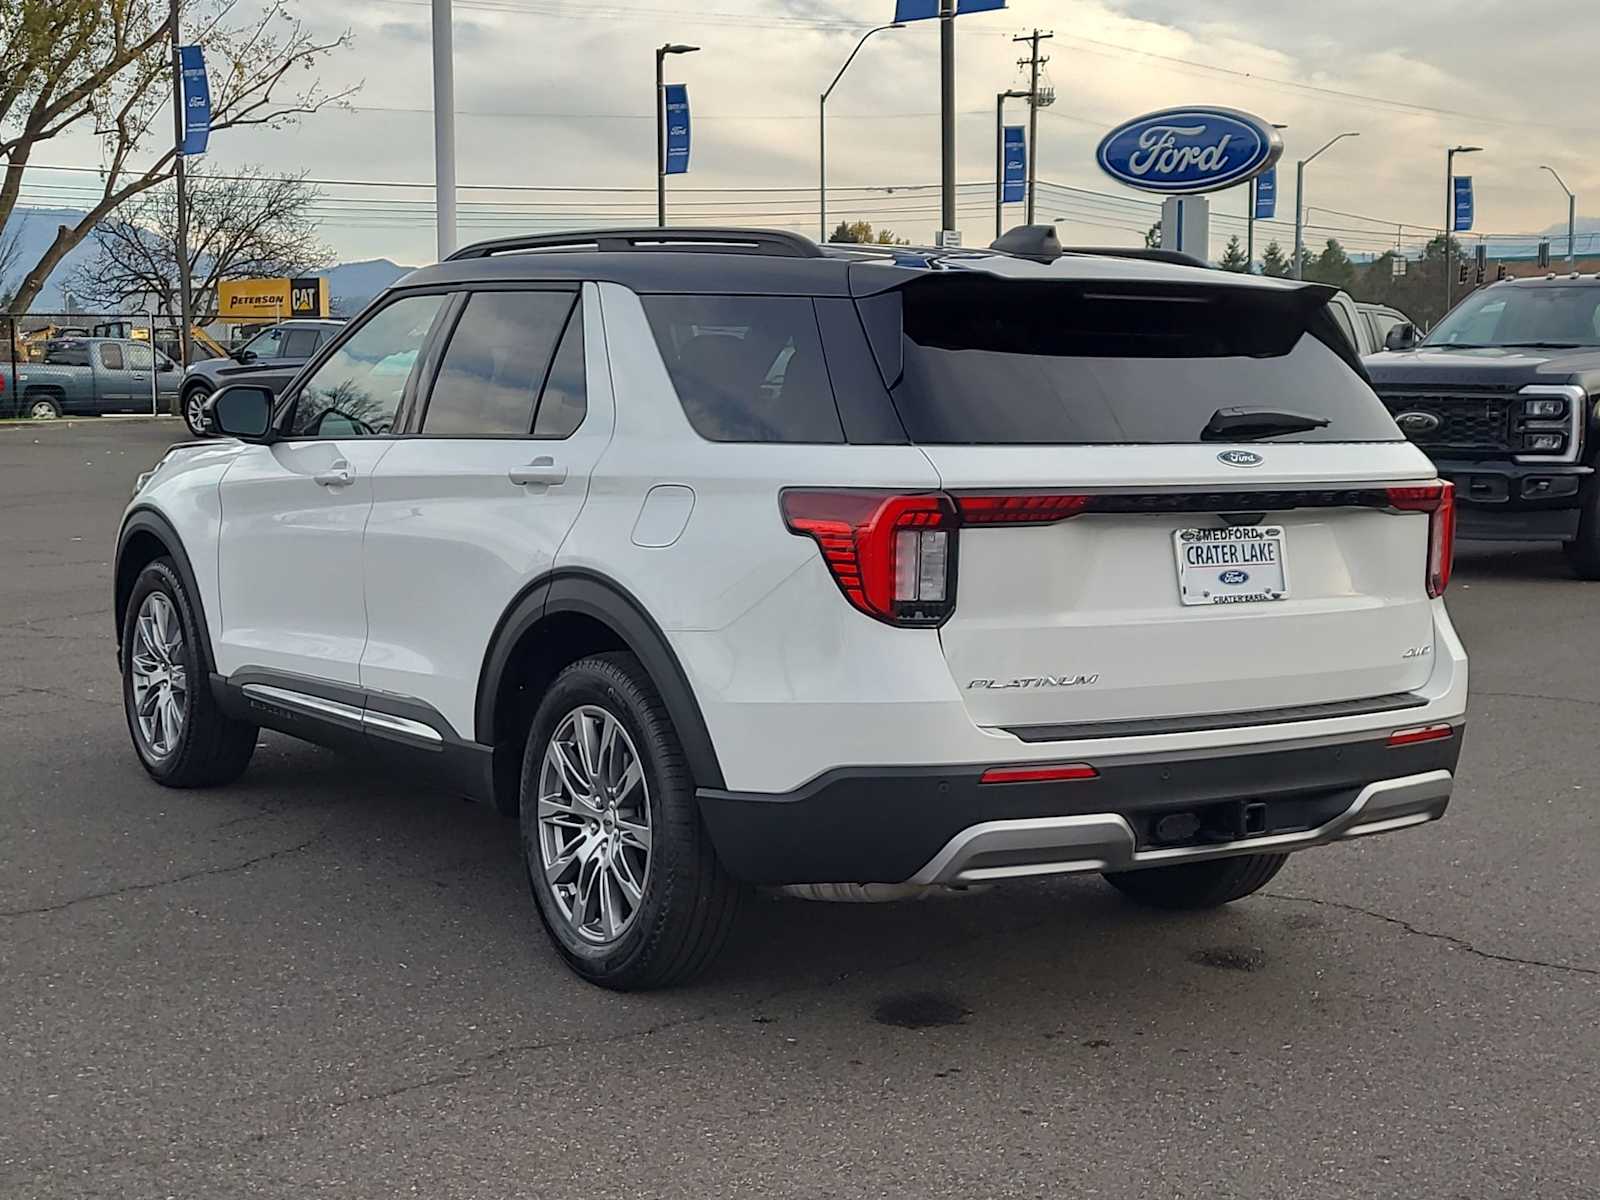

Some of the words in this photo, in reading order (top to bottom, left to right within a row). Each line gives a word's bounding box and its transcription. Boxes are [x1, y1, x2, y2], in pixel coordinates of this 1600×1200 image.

[188, 96, 206, 107] Ford
[671, 126, 687, 136] Ford
[1129, 124, 1232, 176] Ford
[230, 295, 284, 309] PETERSON
[292, 288, 315, 310] CAT
[1230, 450, 1256, 462] Ford
[1202, 528, 1259, 541] MEDFORD
[1187, 544, 1239, 565] CRATER
[1242, 543, 1275, 562] LAKE
[1224, 571, 1245, 584] Ford
[965, 673, 1099, 690] PLATINUM
